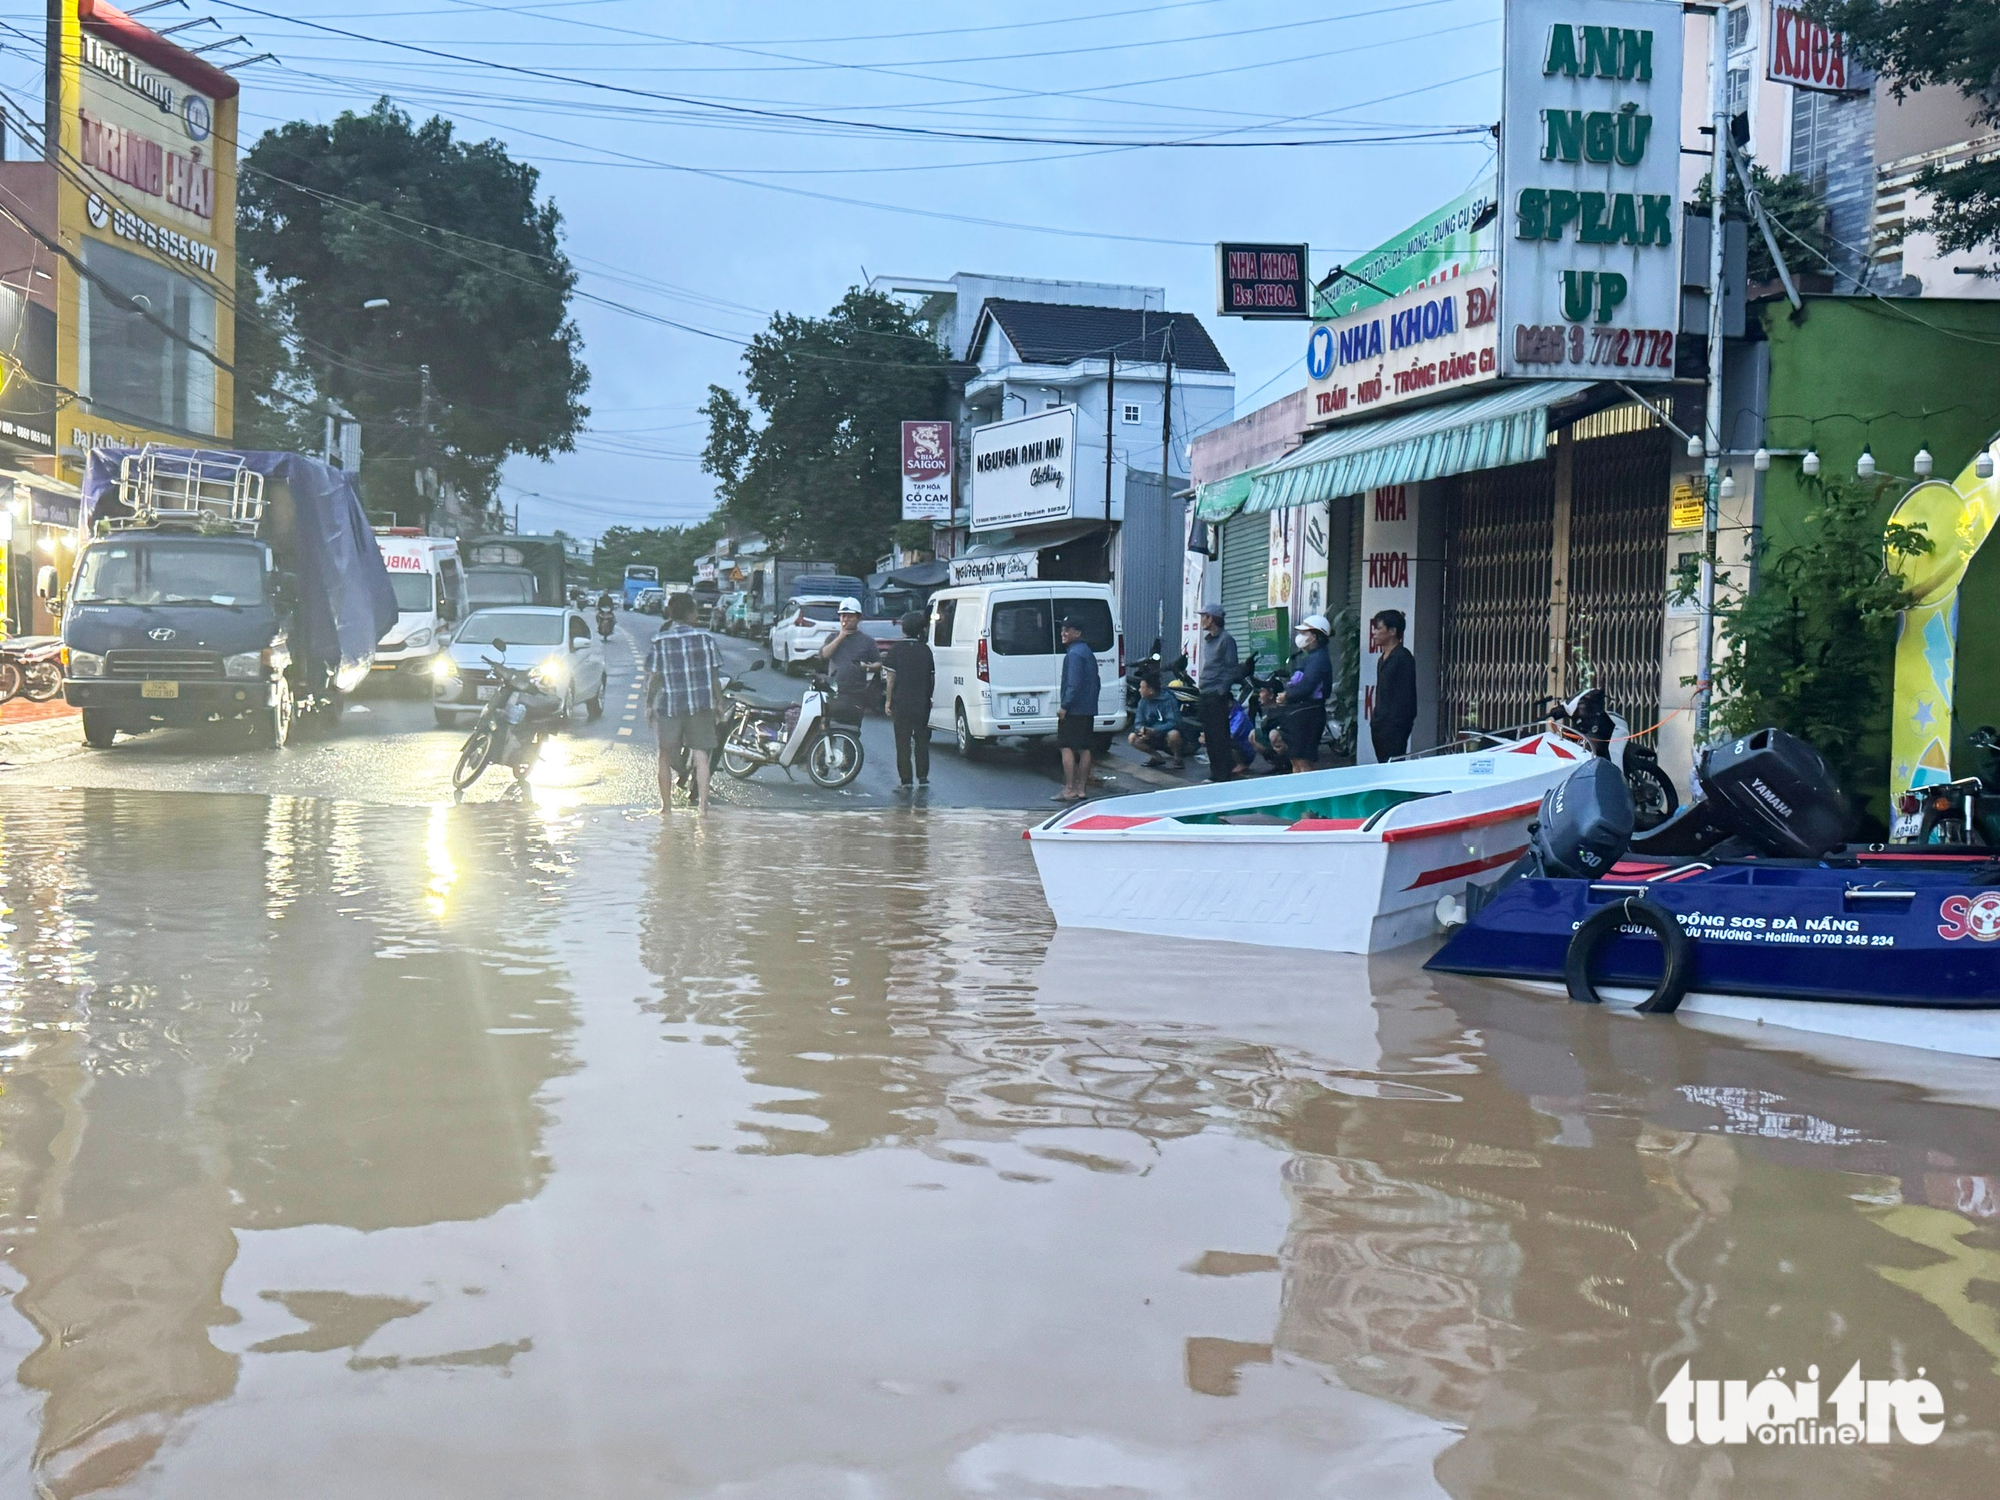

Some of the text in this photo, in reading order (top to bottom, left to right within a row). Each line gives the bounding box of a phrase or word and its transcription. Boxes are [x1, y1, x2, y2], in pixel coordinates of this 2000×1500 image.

[1543, 24, 1653, 81] ANH
[1774, 7, 1846, 89] KHOA
[84, 34, 174, 113] Thời Trang
[1434, 213, 1456, 245] DỤNG
[1458, 206, 1470, 232] CỤ
[1515, 188, 1672, 246] SPEAK
[190, 239, 217, 272] 977
[1228, 251, 1299, 280] NHA KHOA
[1232, 283, 1297, 307] Bs: KHOA
[1558, 269, 1628, 323] UP
[1340, 319, 1385, 366] NHA
[1390, 295, 1458, 351] KHOA
[1316, 384, 1348, 415] TRÁM
[1357, 364, 1383, 405] NHỔ
[1392, 356, 1437, 395] TRỒNG
[1438, 351, 1477, 384] RĂNG
[907, 460, 946, 469] SAIGON
[976, 437, 1063, 473] NGUYEN ANH MY
[1029, 464, 1064, 489] Clothing
[924, 493, 949, 502] CAM
[1375, 485, 1407, 522] NHA
[1368, 551, 1409, 588] KHOA
[1751, 778, 1793, 818] YAMAHA
[1581, 851, 1602, 867] 30
[1676, 911, 1726, 928] ĐỒNG
[1729, 916, 1767, 928] SOS
[1771, 916, 1798, 930] ĐÀ
[1683, 926, 1701, 938] ỨU
[1704, 928, 1752, 941] THƯƠNG
[1764, 931, 1810, 944] Hotline:
[1812, 933, 1842, 945] 0708
[1845, 934, 1868, 945] 345
[1870, 935, 1894, 947] 234
